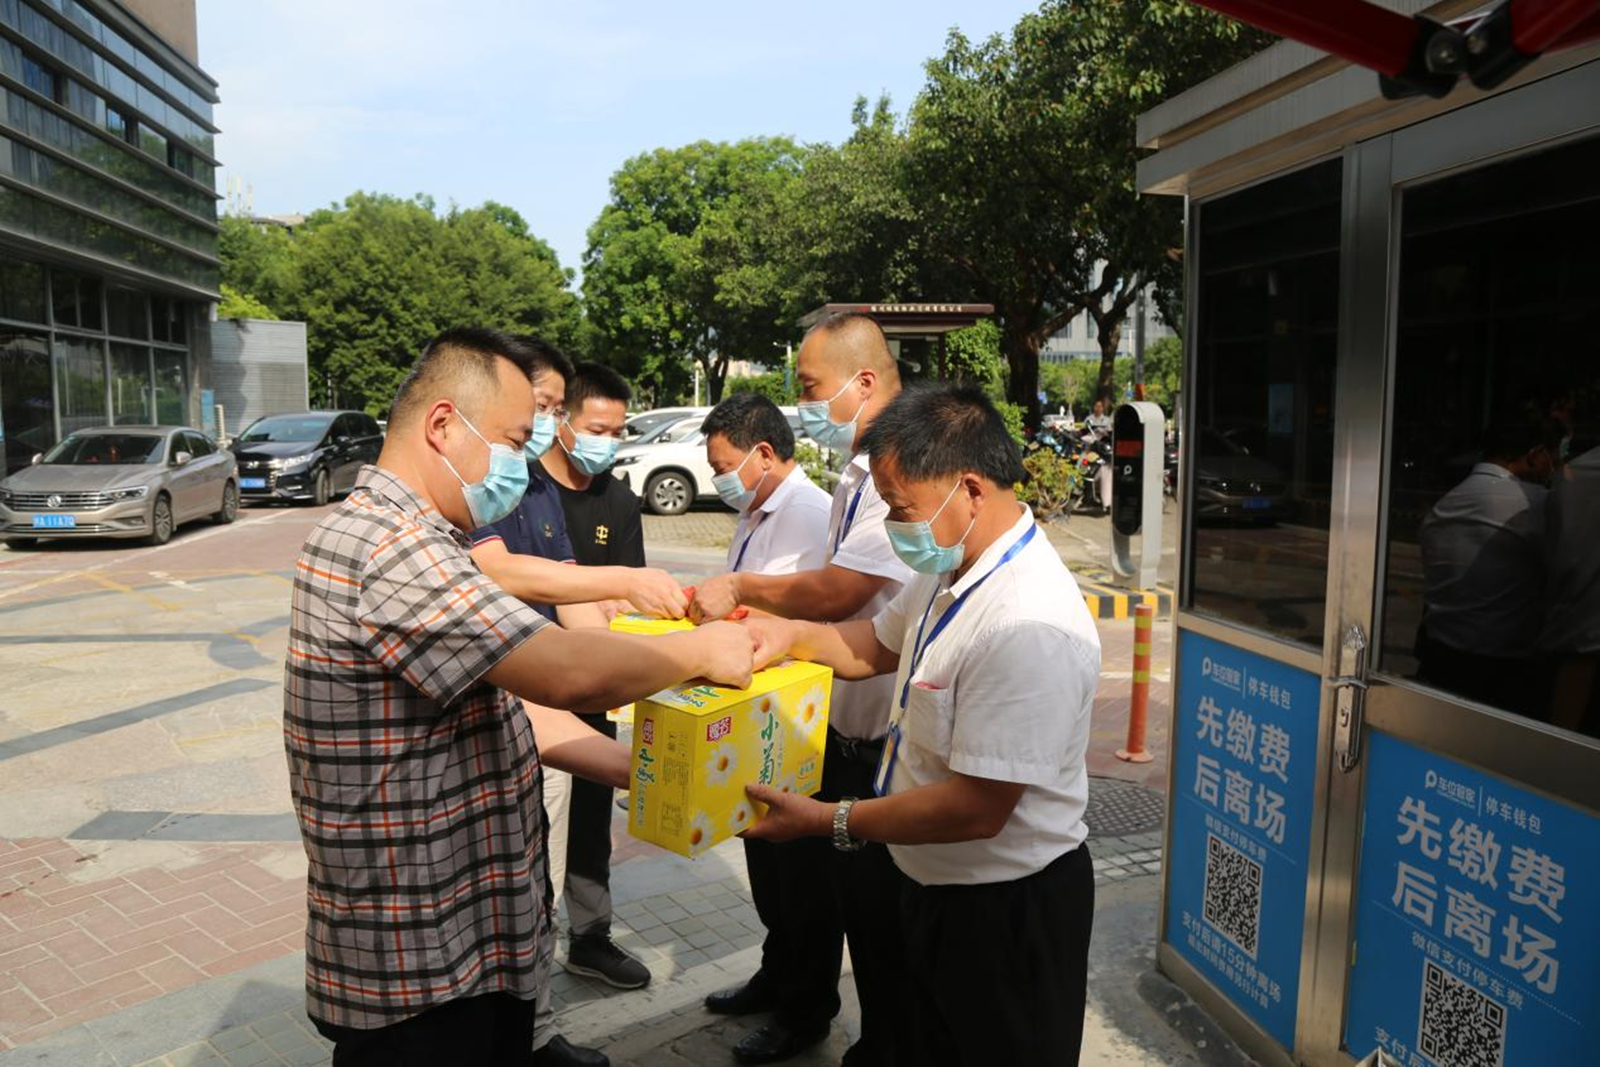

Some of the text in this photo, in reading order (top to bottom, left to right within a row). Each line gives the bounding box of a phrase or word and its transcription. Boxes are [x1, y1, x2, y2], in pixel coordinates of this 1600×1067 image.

[1249, 676, 1291, 710] 停车钱包
[1197, 695, 1291, 783] 先缴费
[1194, 753, 1286, 845] 后离场
[1486, 795, 1541, 835] 停车钱包
[1396, 796, 1566, 924] 先缴费
[1182, 910, 1281, 1003] 支付后请15分钟离场
[1392, 860, 1559, 994] 后离场
[1411, 930, 1523, 1010] 微信支付停车费
[1374, 1026, 1434, 1067] 支付后
